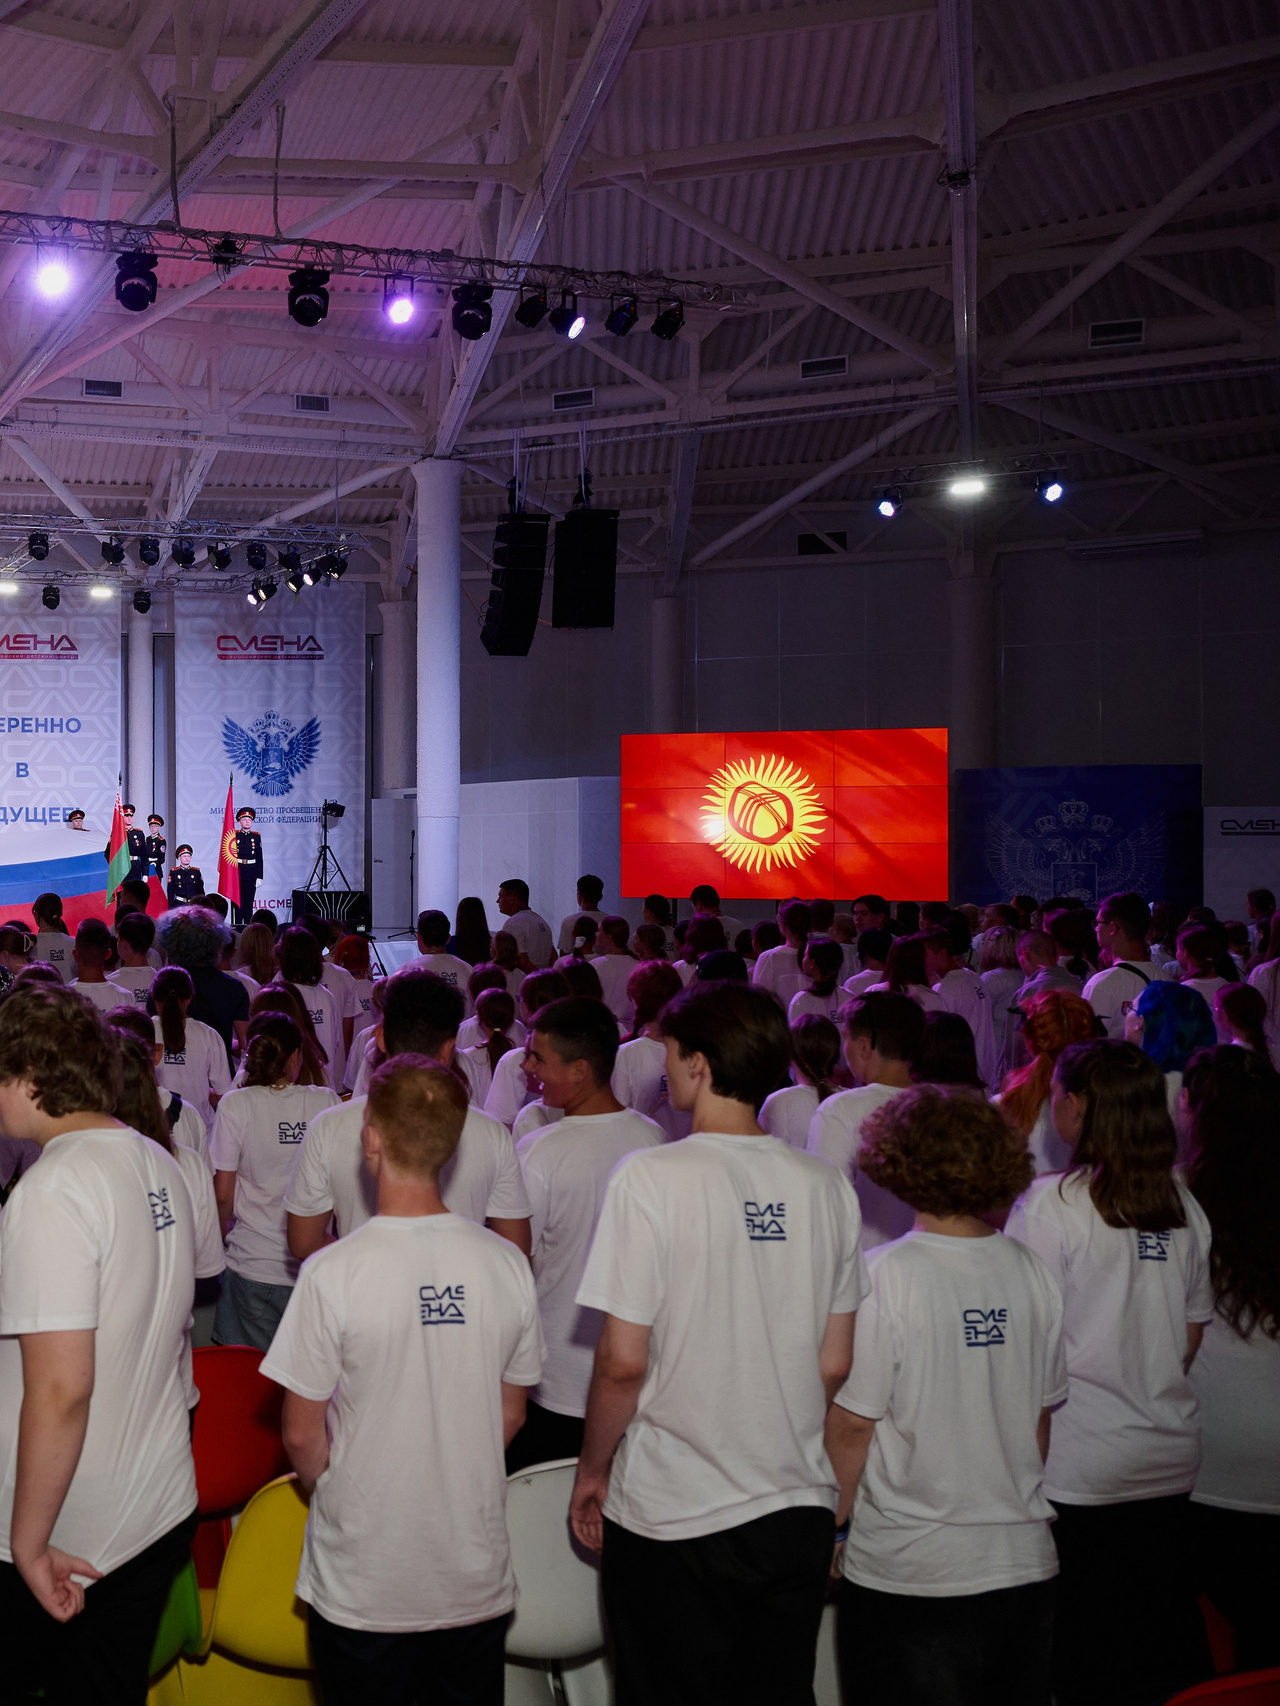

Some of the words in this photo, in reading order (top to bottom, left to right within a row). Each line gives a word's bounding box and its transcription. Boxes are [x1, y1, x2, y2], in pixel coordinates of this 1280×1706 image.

[216, 634, 324, 652] СМЕНА
[16, 762, 30, 778] В
[276, 815, 321, 824] ФЕДЕРАЦИИ
